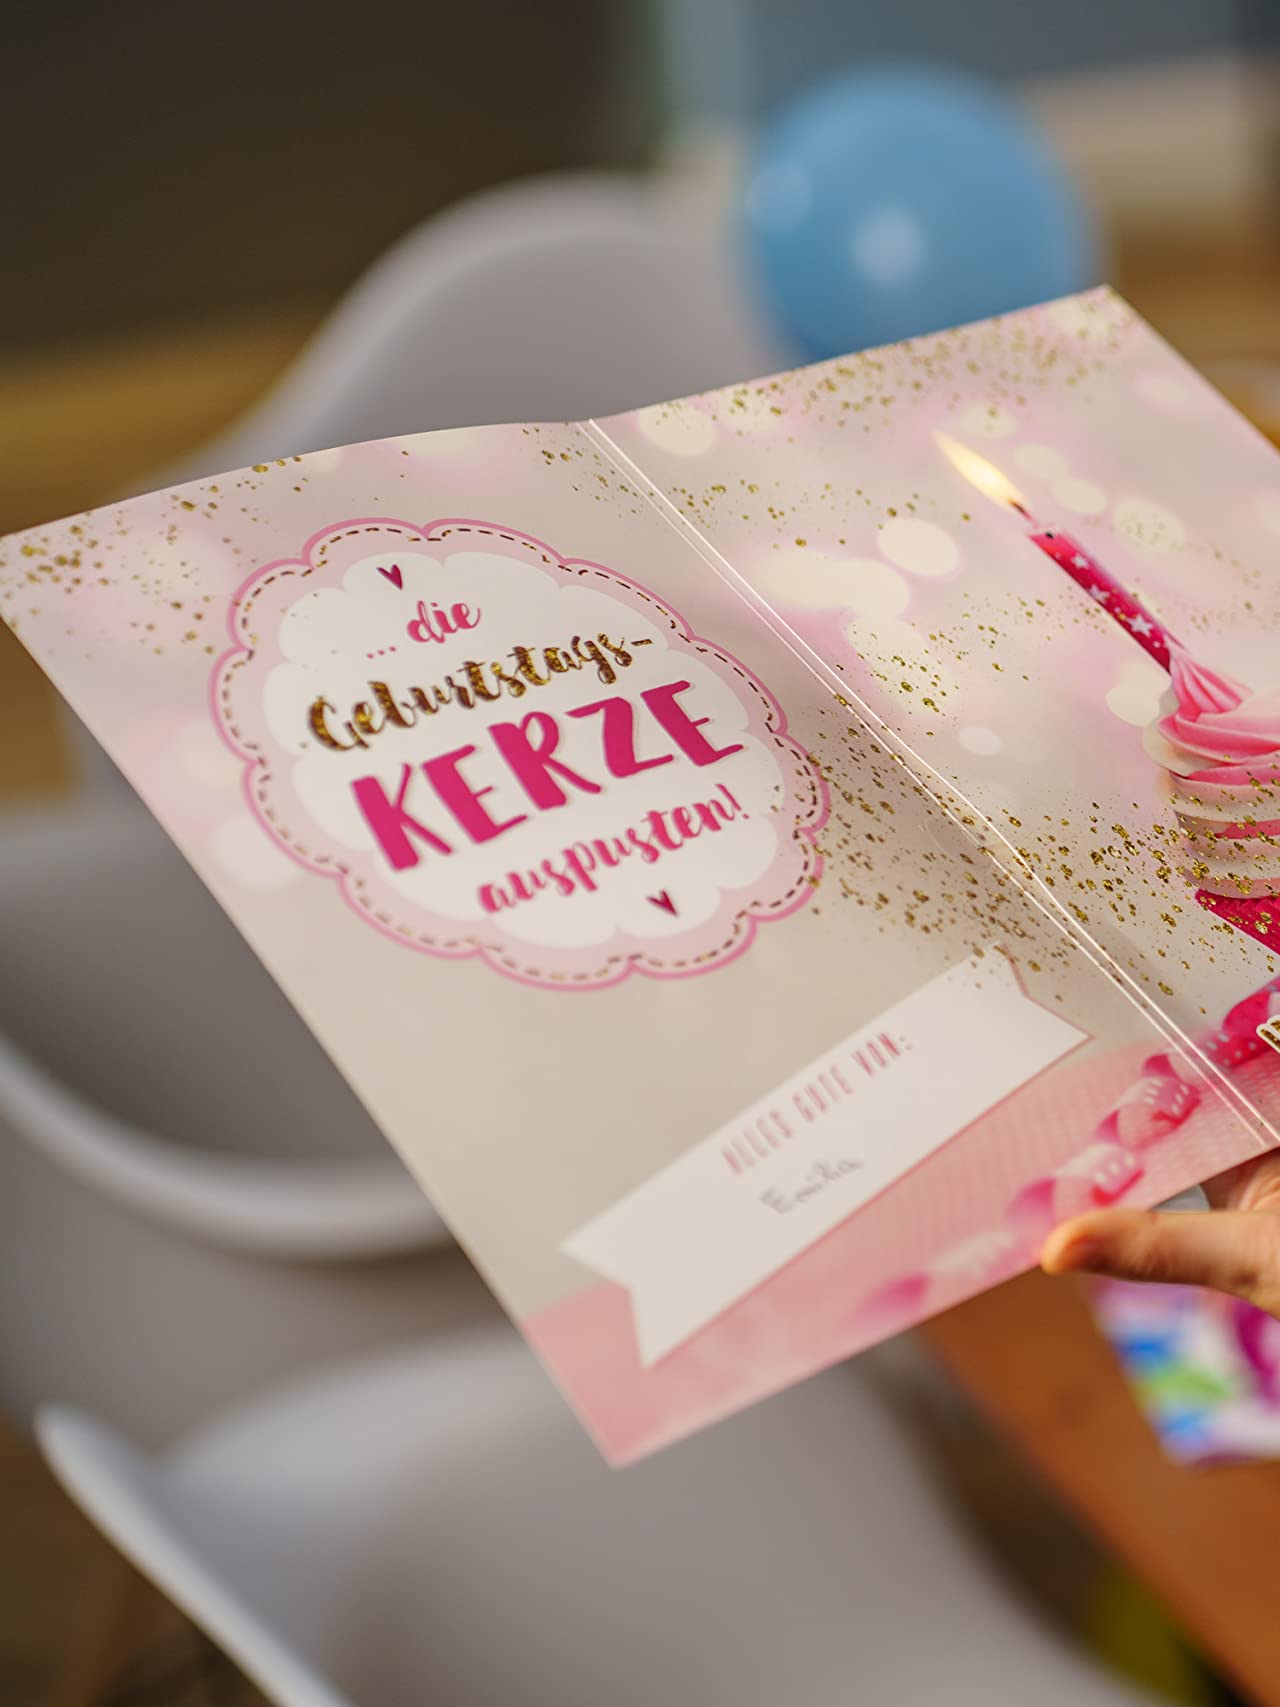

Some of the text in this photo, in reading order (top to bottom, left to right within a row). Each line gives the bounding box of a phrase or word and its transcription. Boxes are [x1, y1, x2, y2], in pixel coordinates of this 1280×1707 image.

[406, 600, 481, 643] die
[308, 632, 653, 751] Geburtstags-
[350, 680, 744, 872] KERZE
[477, 783, 750, 913] auspusten!
[722, 1109, 794, 1174] ALLES
[792, 1065, 853, 1122] GUTE
